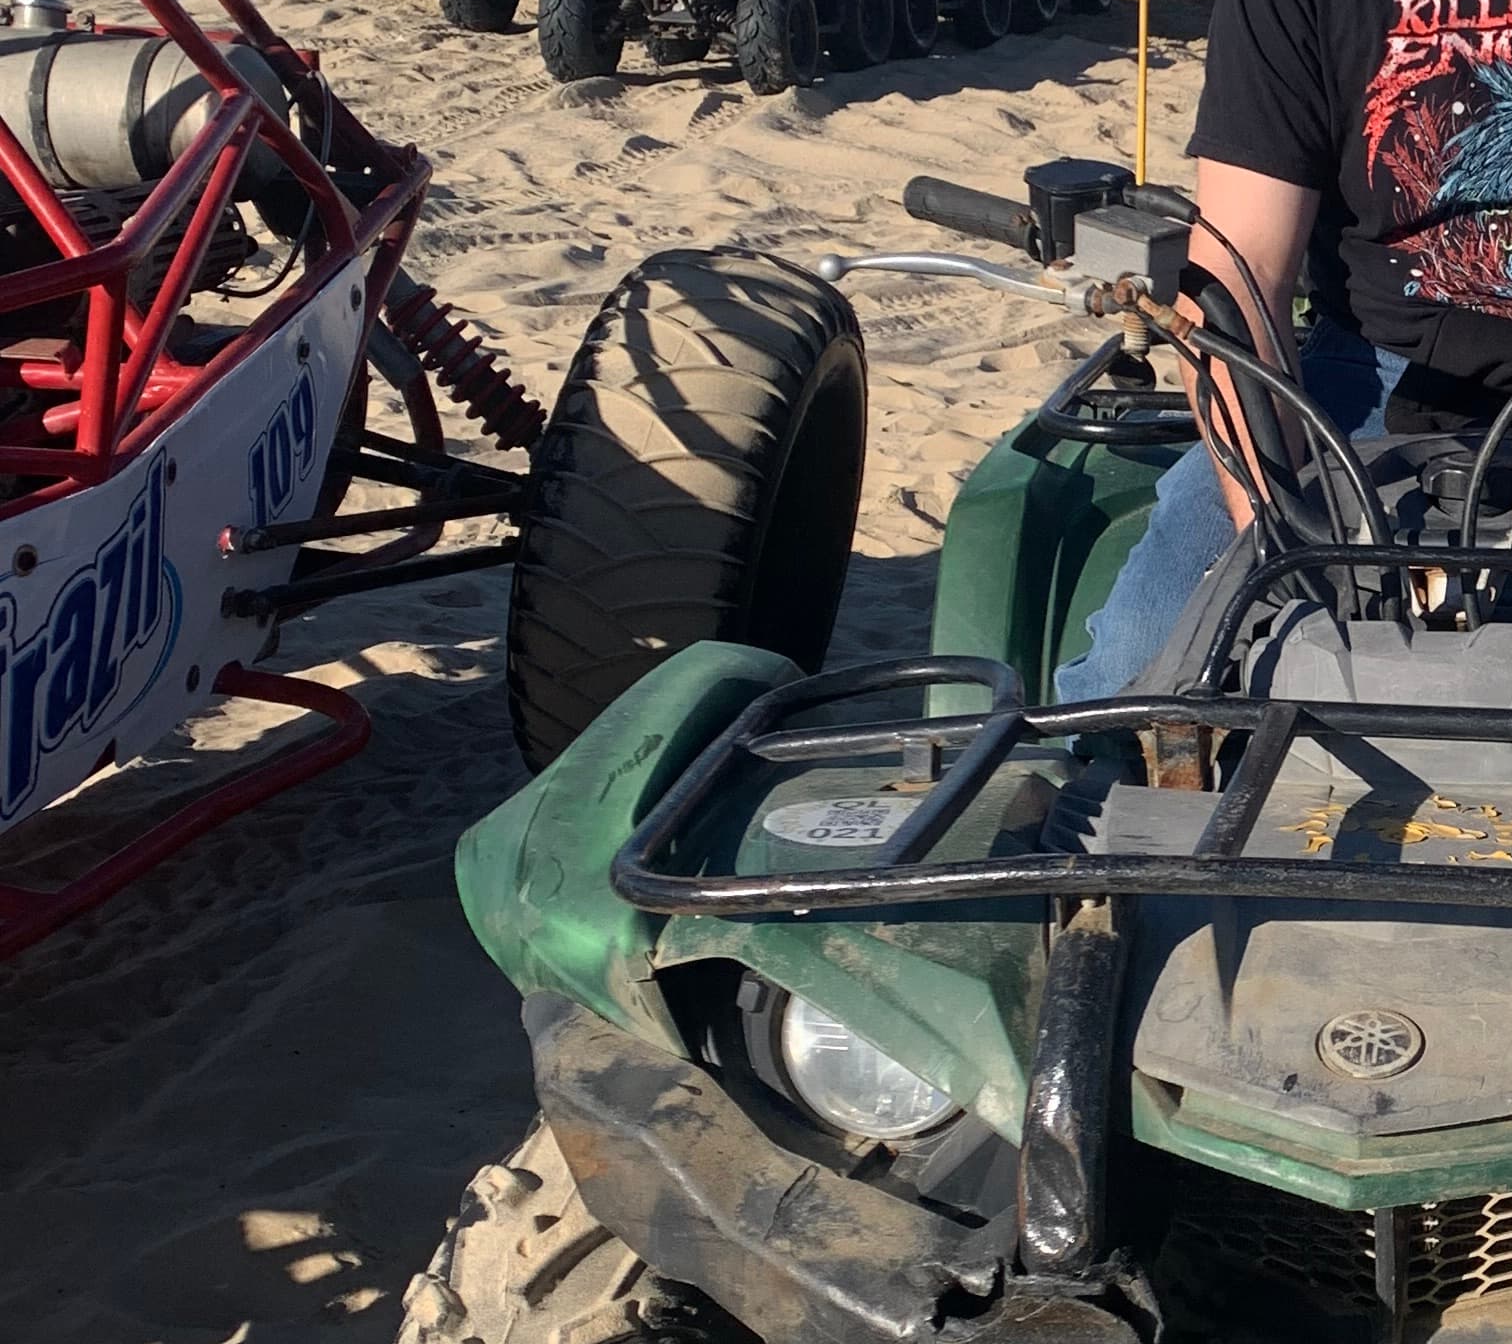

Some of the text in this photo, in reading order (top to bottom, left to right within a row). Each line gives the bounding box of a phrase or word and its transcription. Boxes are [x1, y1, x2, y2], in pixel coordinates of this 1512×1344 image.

[250, 364, 316, 527] 109
[0, 449, 165, 820] razil
[806, 827, 883, 839] 021
